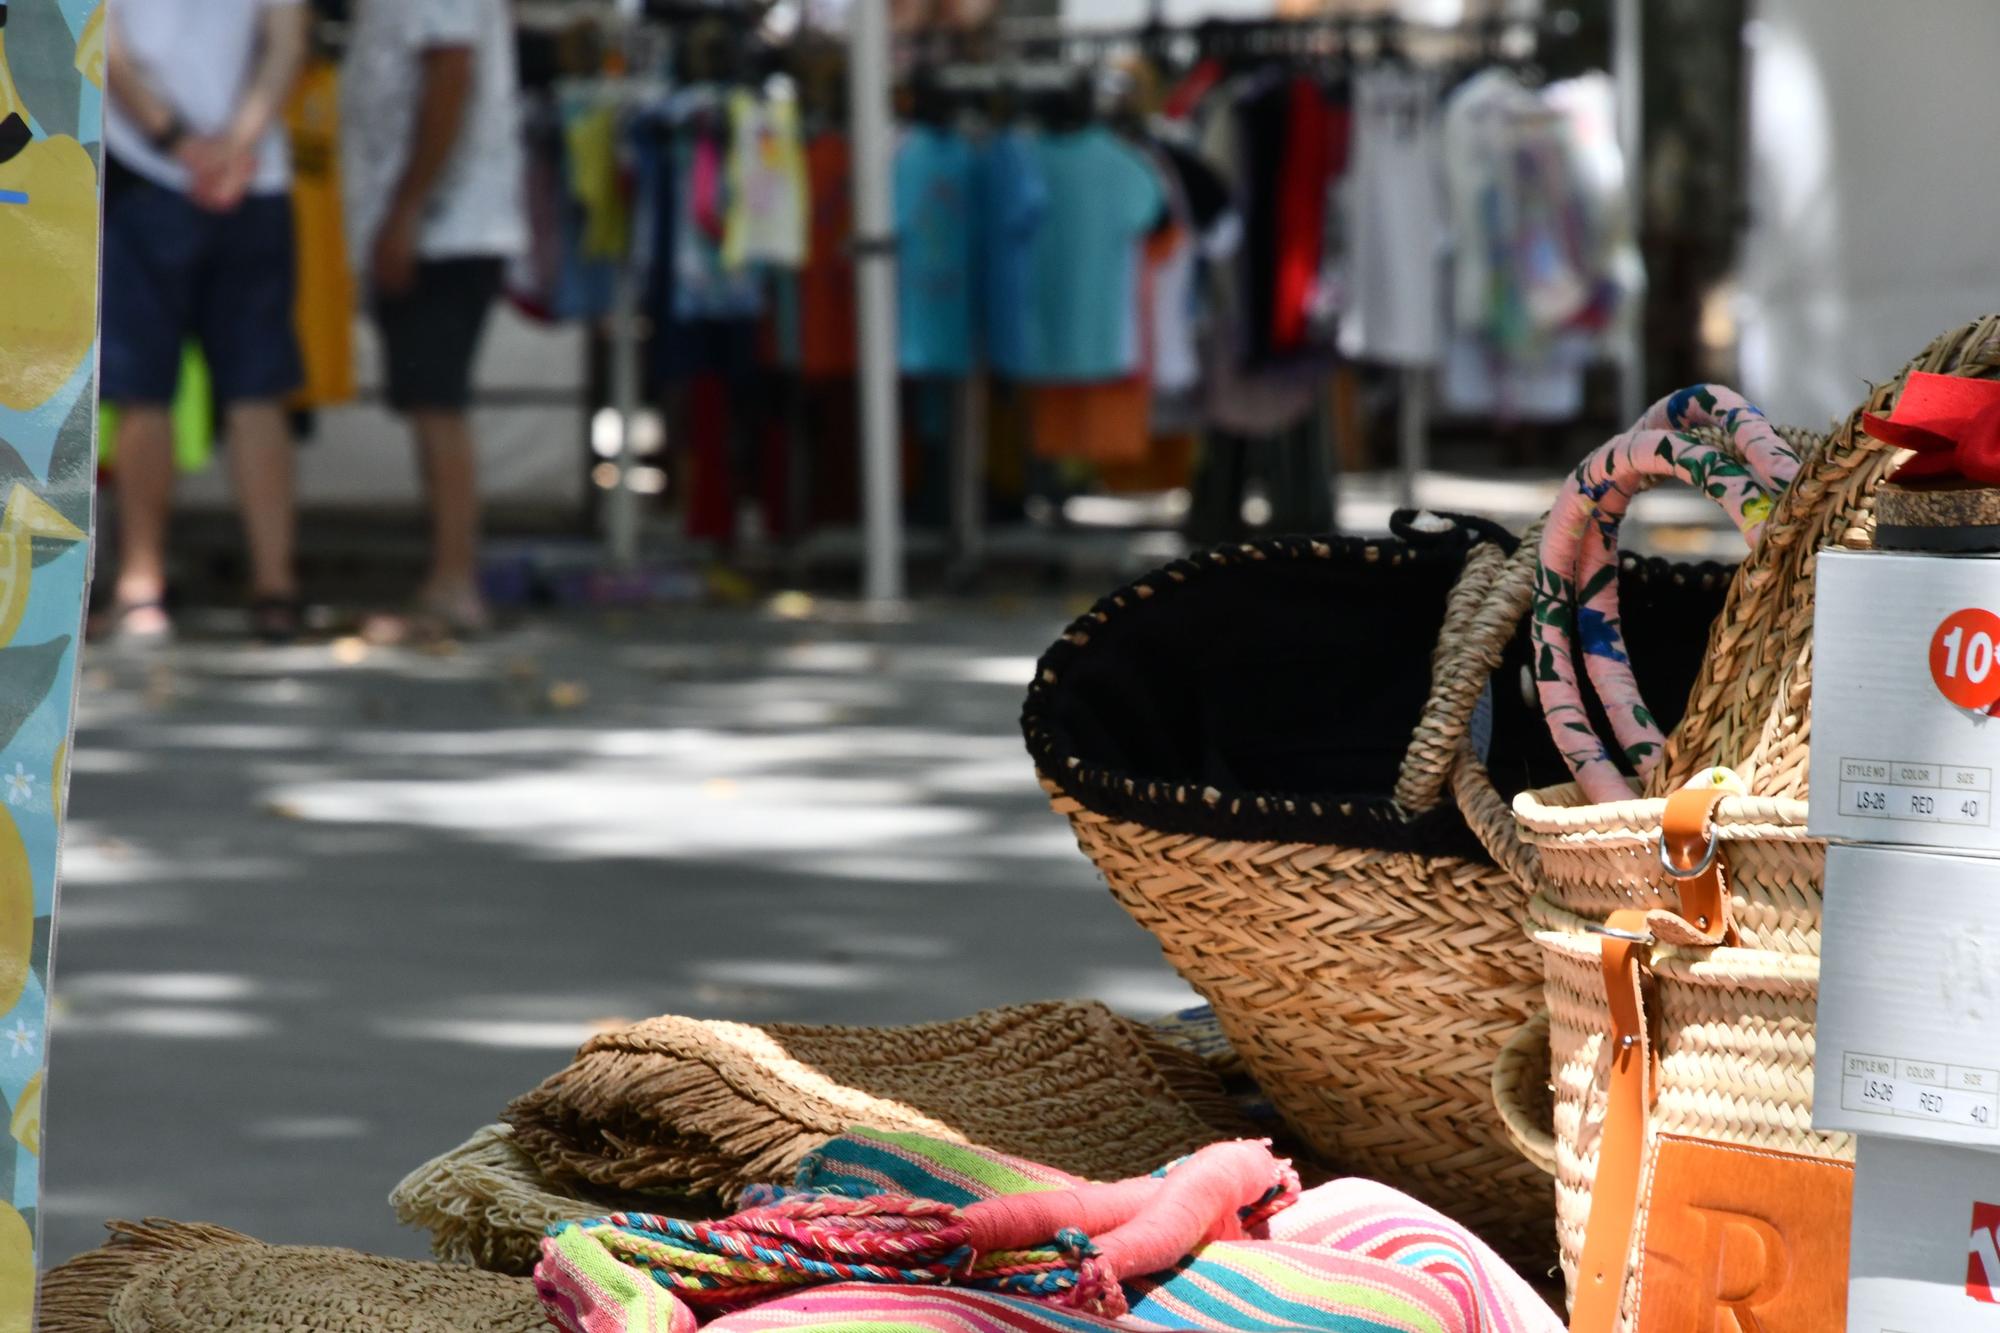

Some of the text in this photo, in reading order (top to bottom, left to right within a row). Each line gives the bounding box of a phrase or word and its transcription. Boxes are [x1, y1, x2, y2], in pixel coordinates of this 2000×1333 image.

[1943, 626, 2000, 684] 10
[1901, 768, 1930, 781] COLOR
[1956, 772, 1975, 784] SIZE
[1856, 791, 1978, 817] LS-26 RED 40
[1906, 1065, 1936, 1080] COLOR
[1963, 1073, 1983, 1086] SIZE
[1864, 1079, 1988, 1123] LS-26 RED 40
